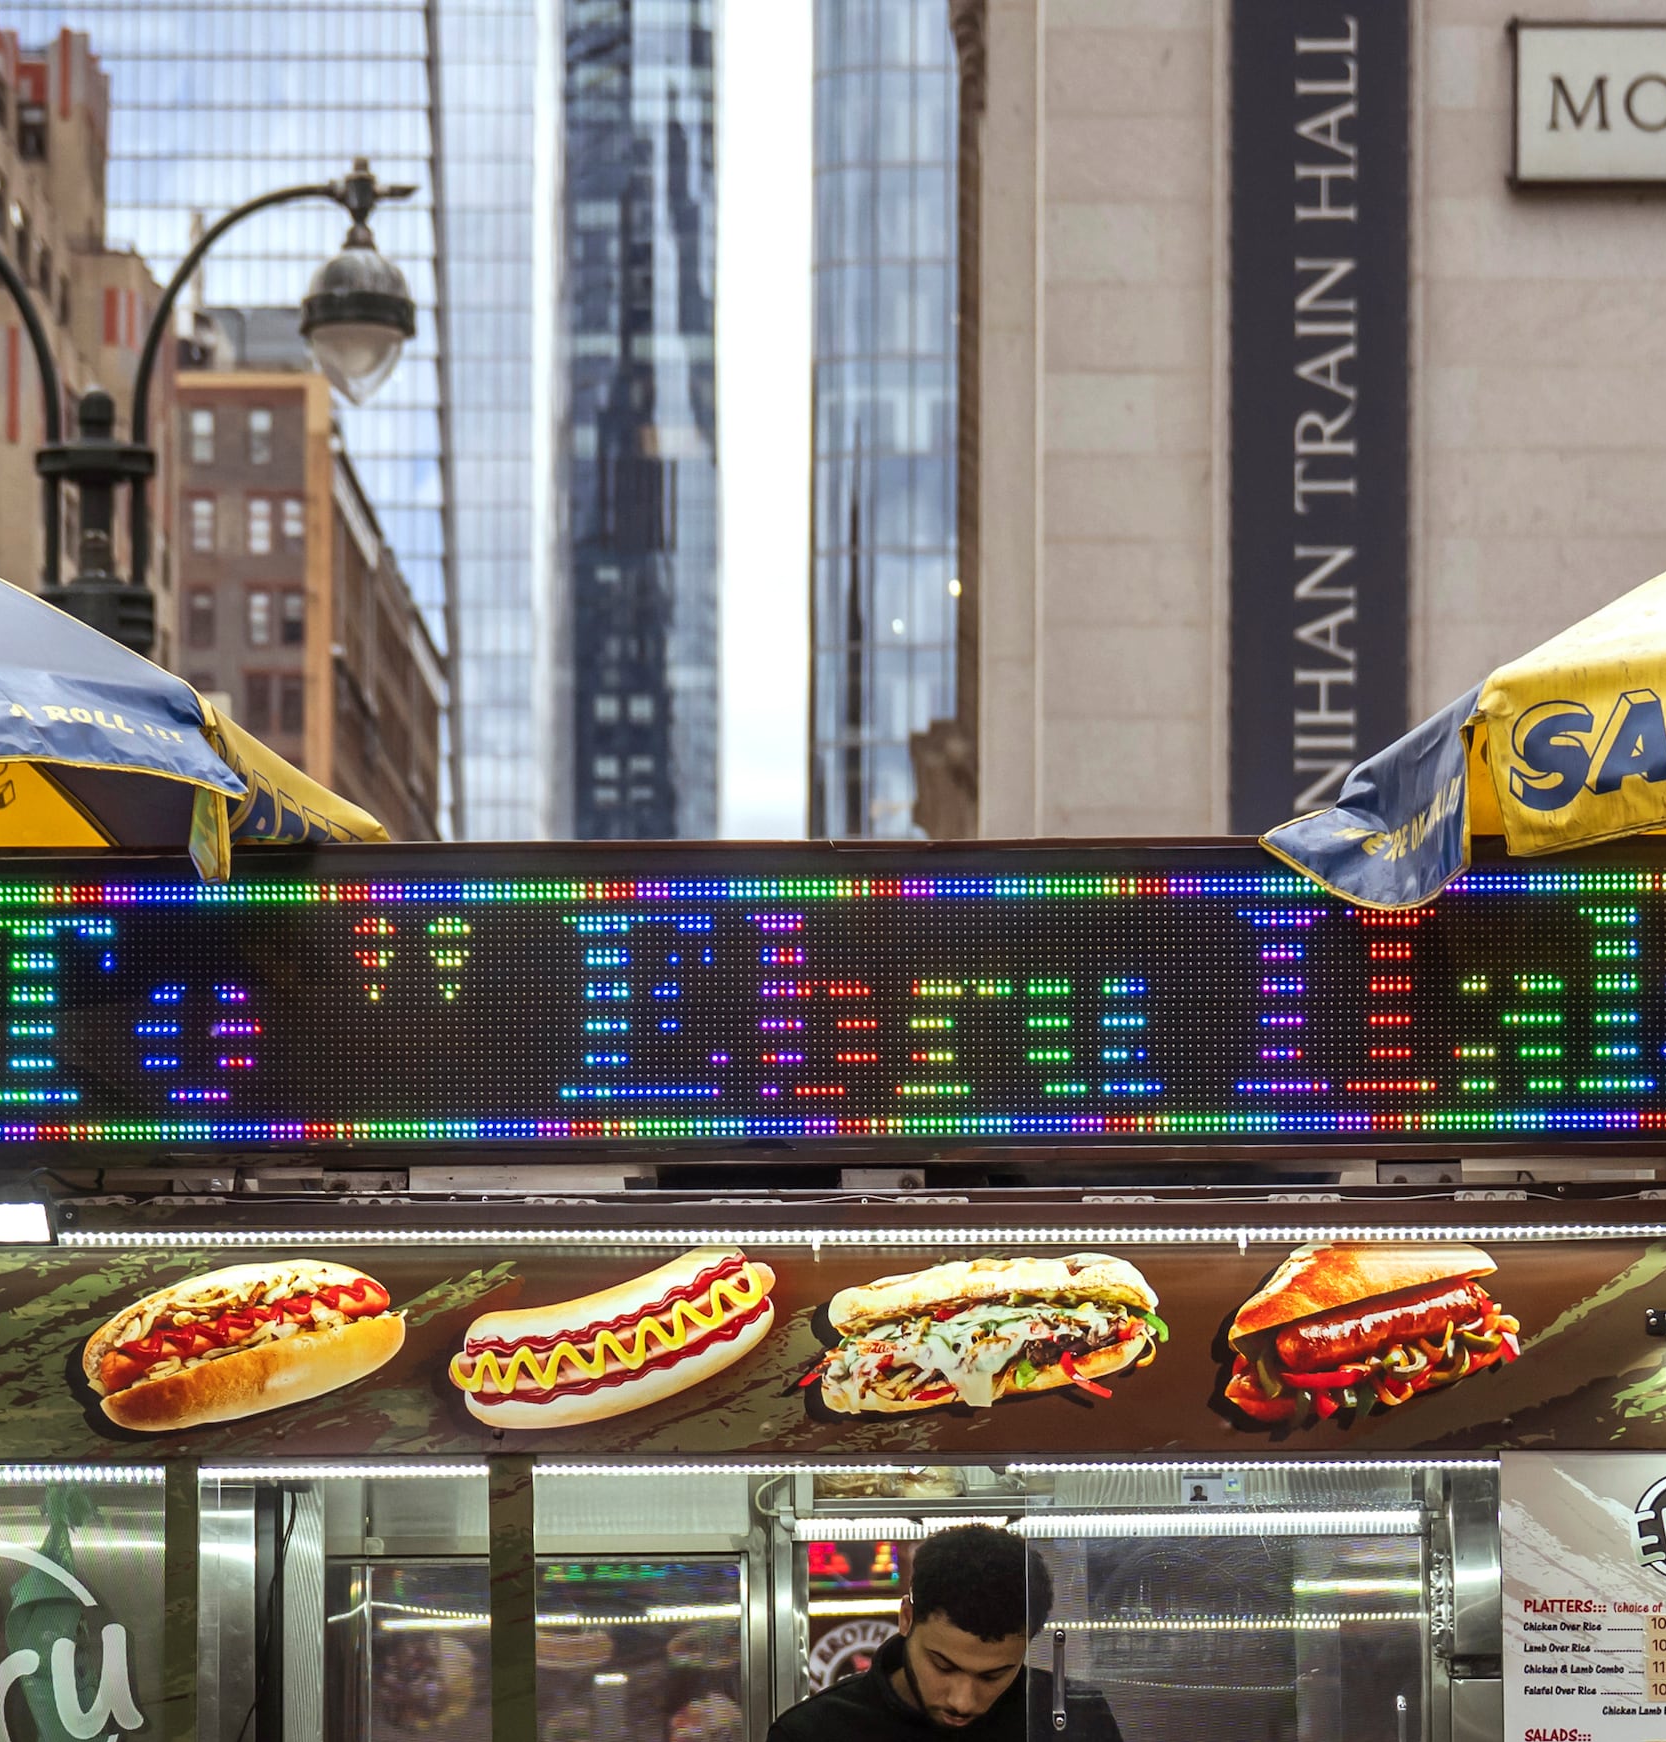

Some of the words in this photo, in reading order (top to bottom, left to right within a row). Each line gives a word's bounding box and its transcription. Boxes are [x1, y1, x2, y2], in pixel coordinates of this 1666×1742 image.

[1294, 15, 1359, 223] HALL
[1294, 257, 1359, 516] TRAIN
[8, 700, 36, 723] A
[41, 705, 134, 736] ROLL
[144, 720, 185, 745] !!!
[1523, 1622, 1558, 1632] Chicken
[1559, 1622, 1581, 1632] Over
[1582, 1622, 1602, 1632] Rice
[1613, 1601, 1650, 1613] (choice
[1652, 1602, 1664, 1613] of
